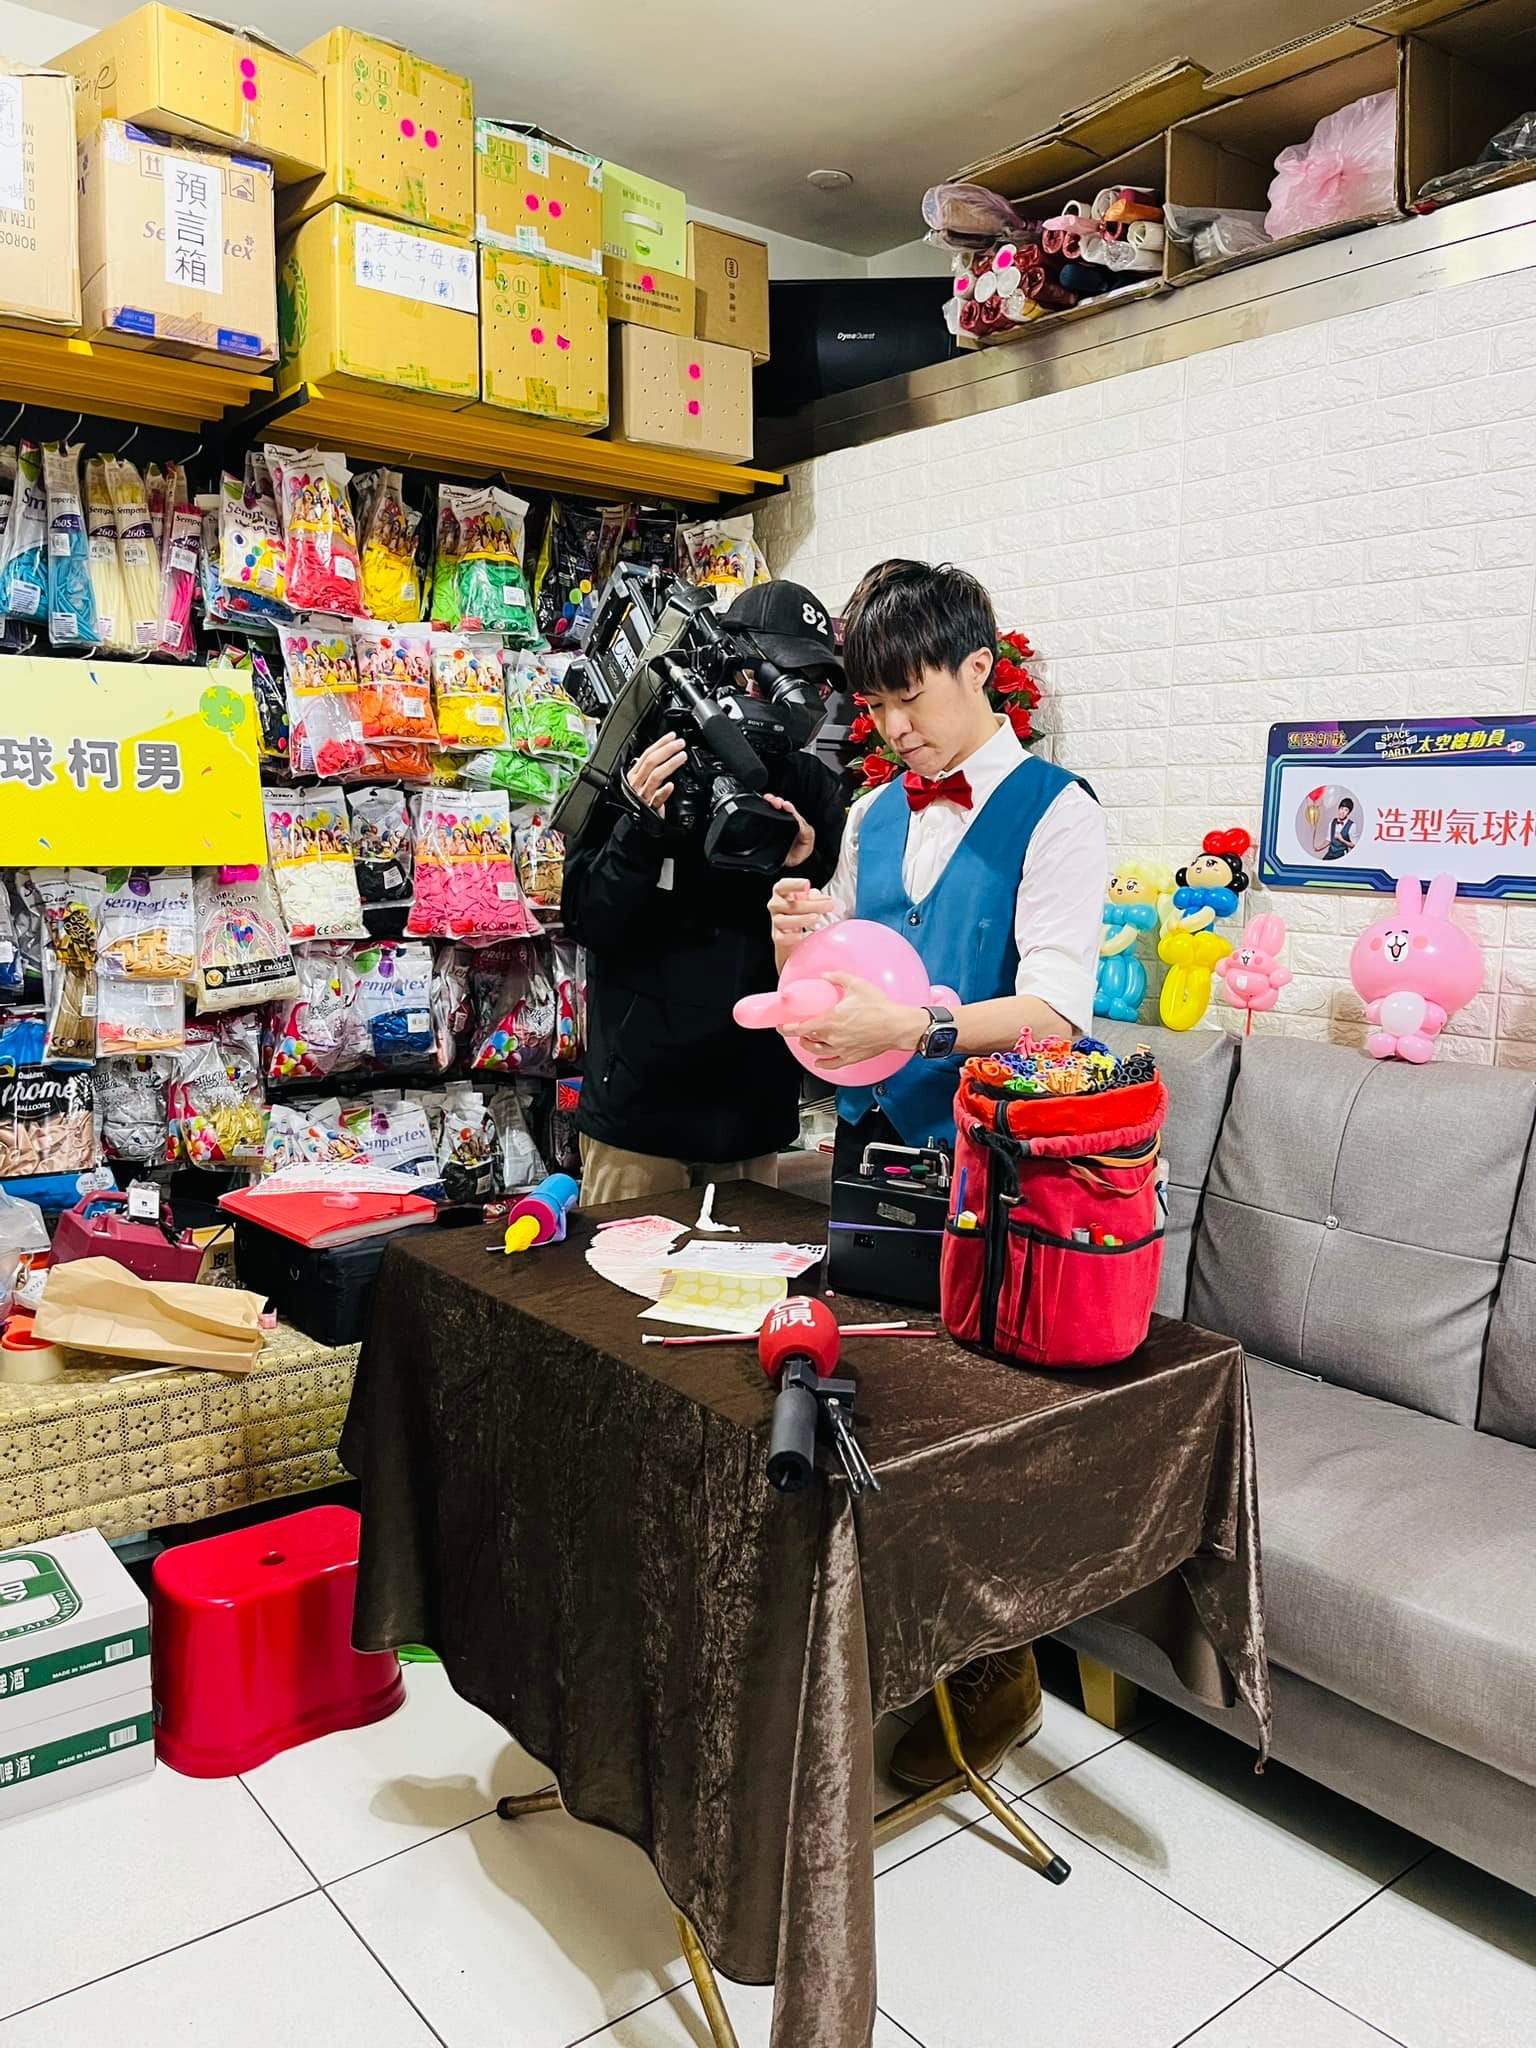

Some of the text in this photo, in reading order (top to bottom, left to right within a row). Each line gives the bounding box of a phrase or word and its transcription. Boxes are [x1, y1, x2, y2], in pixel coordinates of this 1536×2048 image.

[174, 170, 208, 286] 預言箱
[89, 505, 114, 516] Sempe
[126, 528, 146, 538] 260S
[802, 602, 828, 636] 82
[1381, 728, 1410, 742] SPACE
[1416, 728, 1506, 753] 太空總動員
[1381, 745, 1414, 760] PARTY
[0, 736, 182, 789] 球柯男
[317, 925, 329, 936] CE
[52, 1669, 71, 1679] MADE
[79, 1660, 103, 1671] TAIWAN
[57, 1755, 76, 1765] MADE
[84, 1745, 107, 1757] TAIWAN
